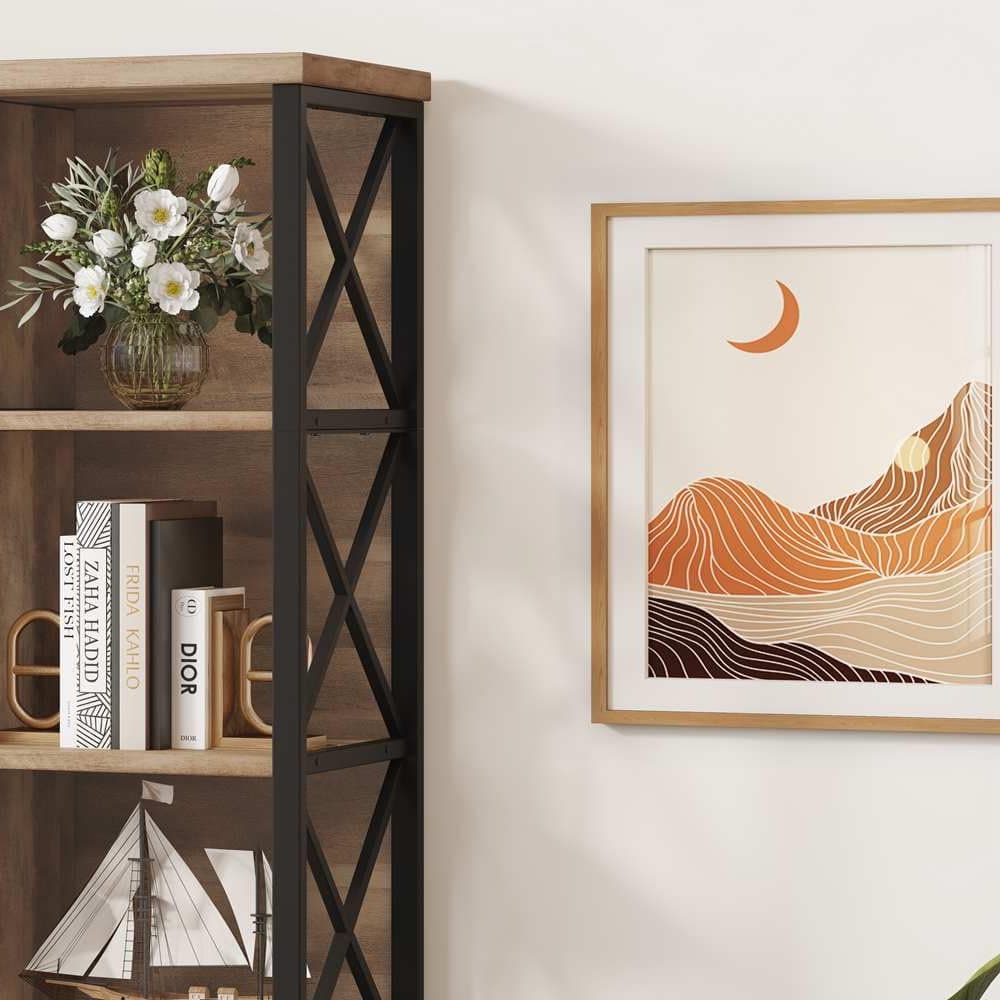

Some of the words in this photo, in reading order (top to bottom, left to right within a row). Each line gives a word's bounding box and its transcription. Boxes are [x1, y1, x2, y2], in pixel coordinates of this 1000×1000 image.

[63, 542, 74, 590] LOST
[84, 560, 99, 614] ZAHA
[126, 565, 140, 616] FRIDA
[63, 597, 74, 639] FISH
[84, 620, 99, 683] HADID
[126, 629, 140, 690] KAHLO
[180, 643, 198, 695] DIOR
